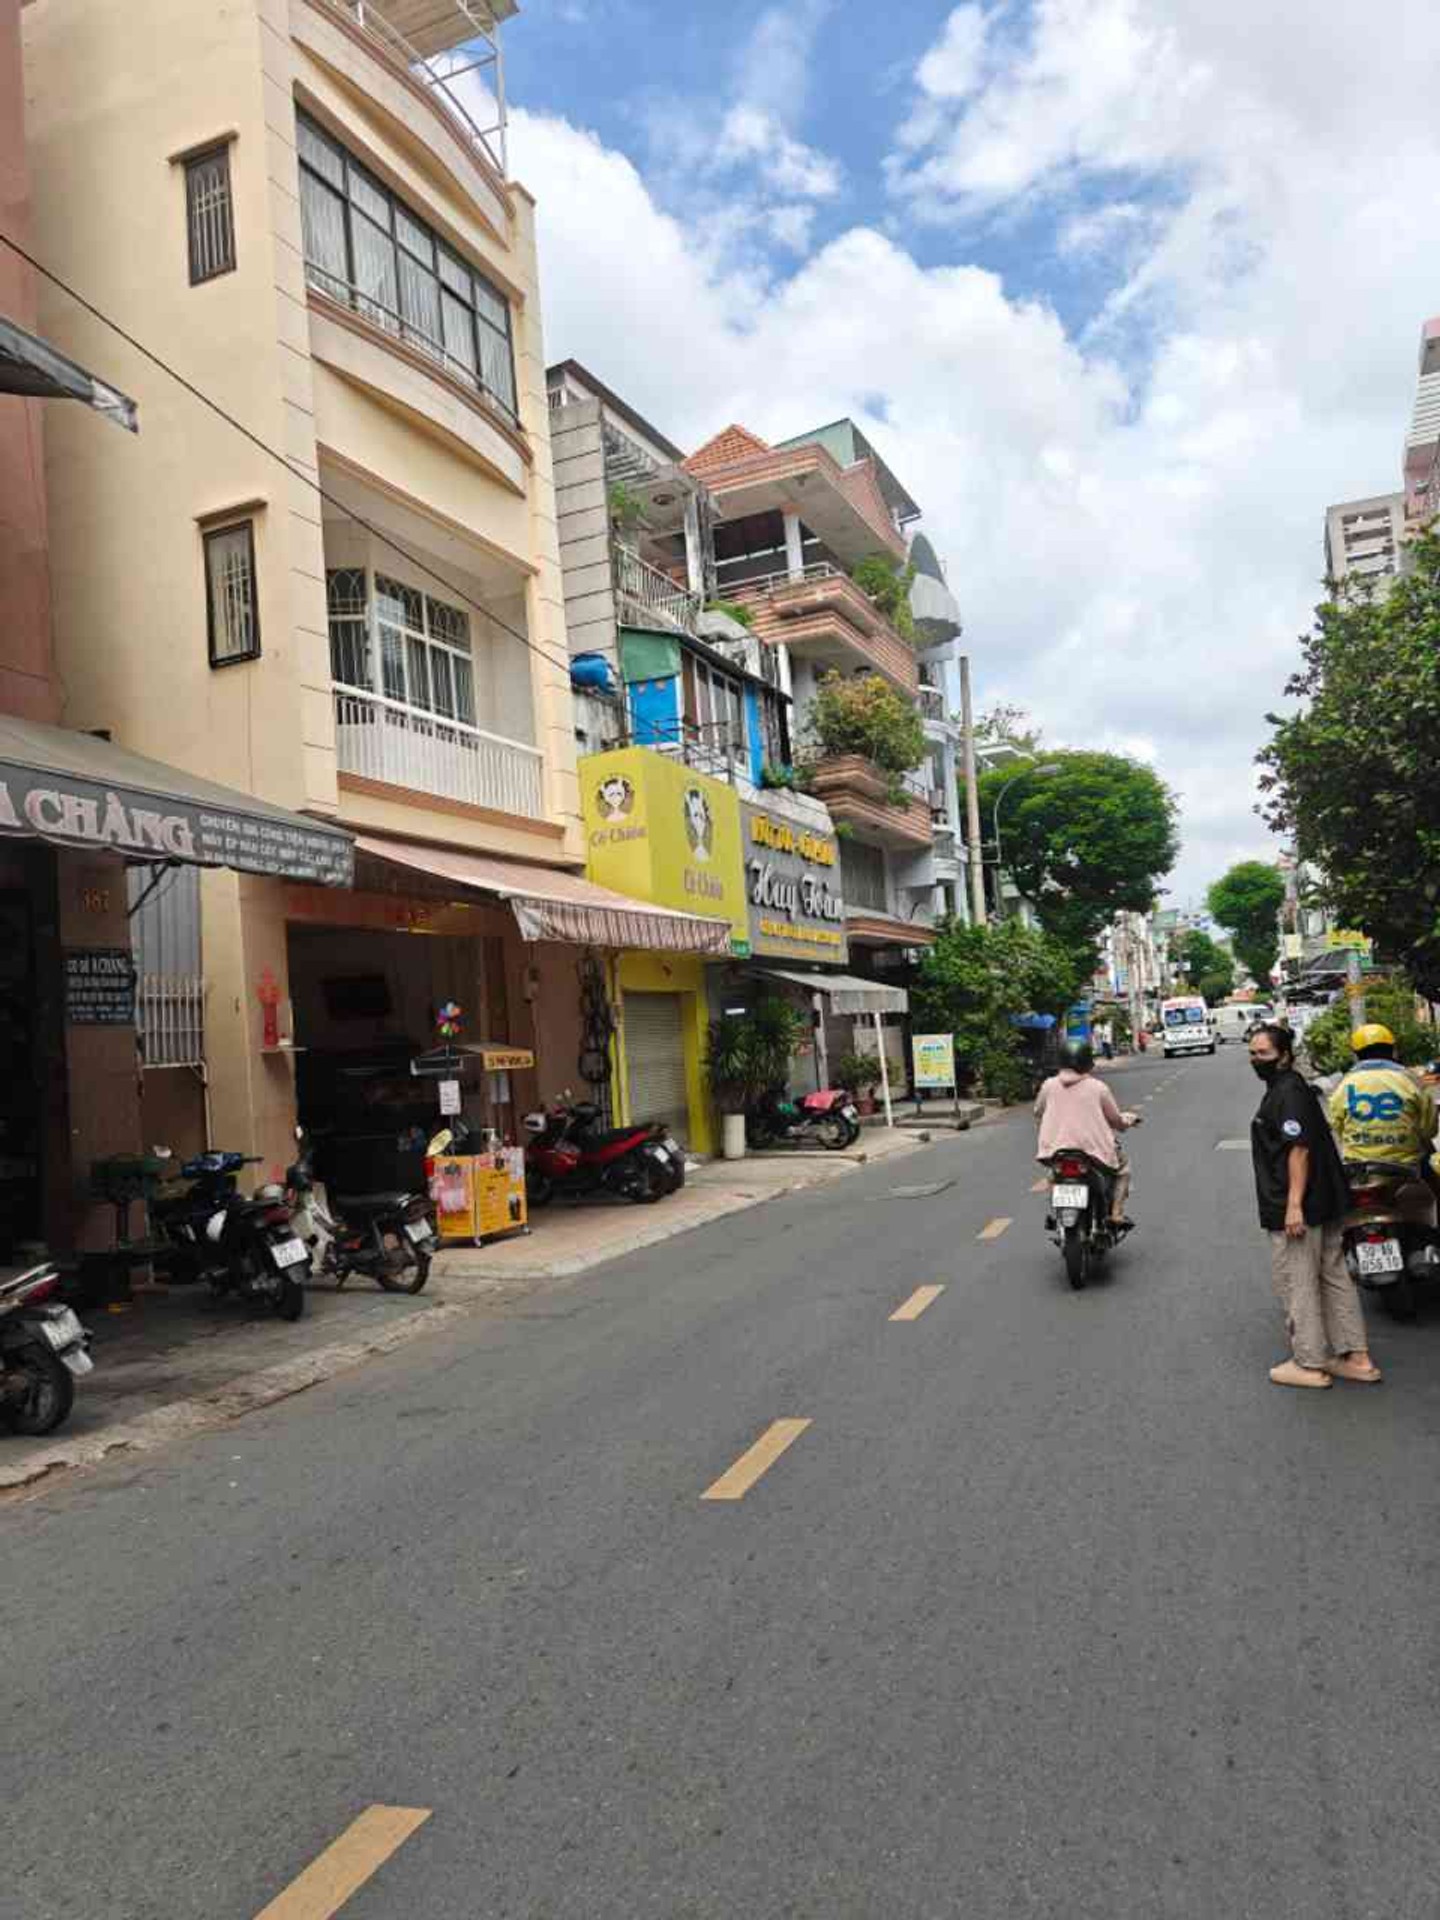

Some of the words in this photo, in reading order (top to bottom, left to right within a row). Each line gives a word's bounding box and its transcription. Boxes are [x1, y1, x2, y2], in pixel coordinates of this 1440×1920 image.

[24, 788, 195, 858] CHÀNG
[751, 858, 797, 921] Huy
[1348, 1084, 1403, 1121] be
